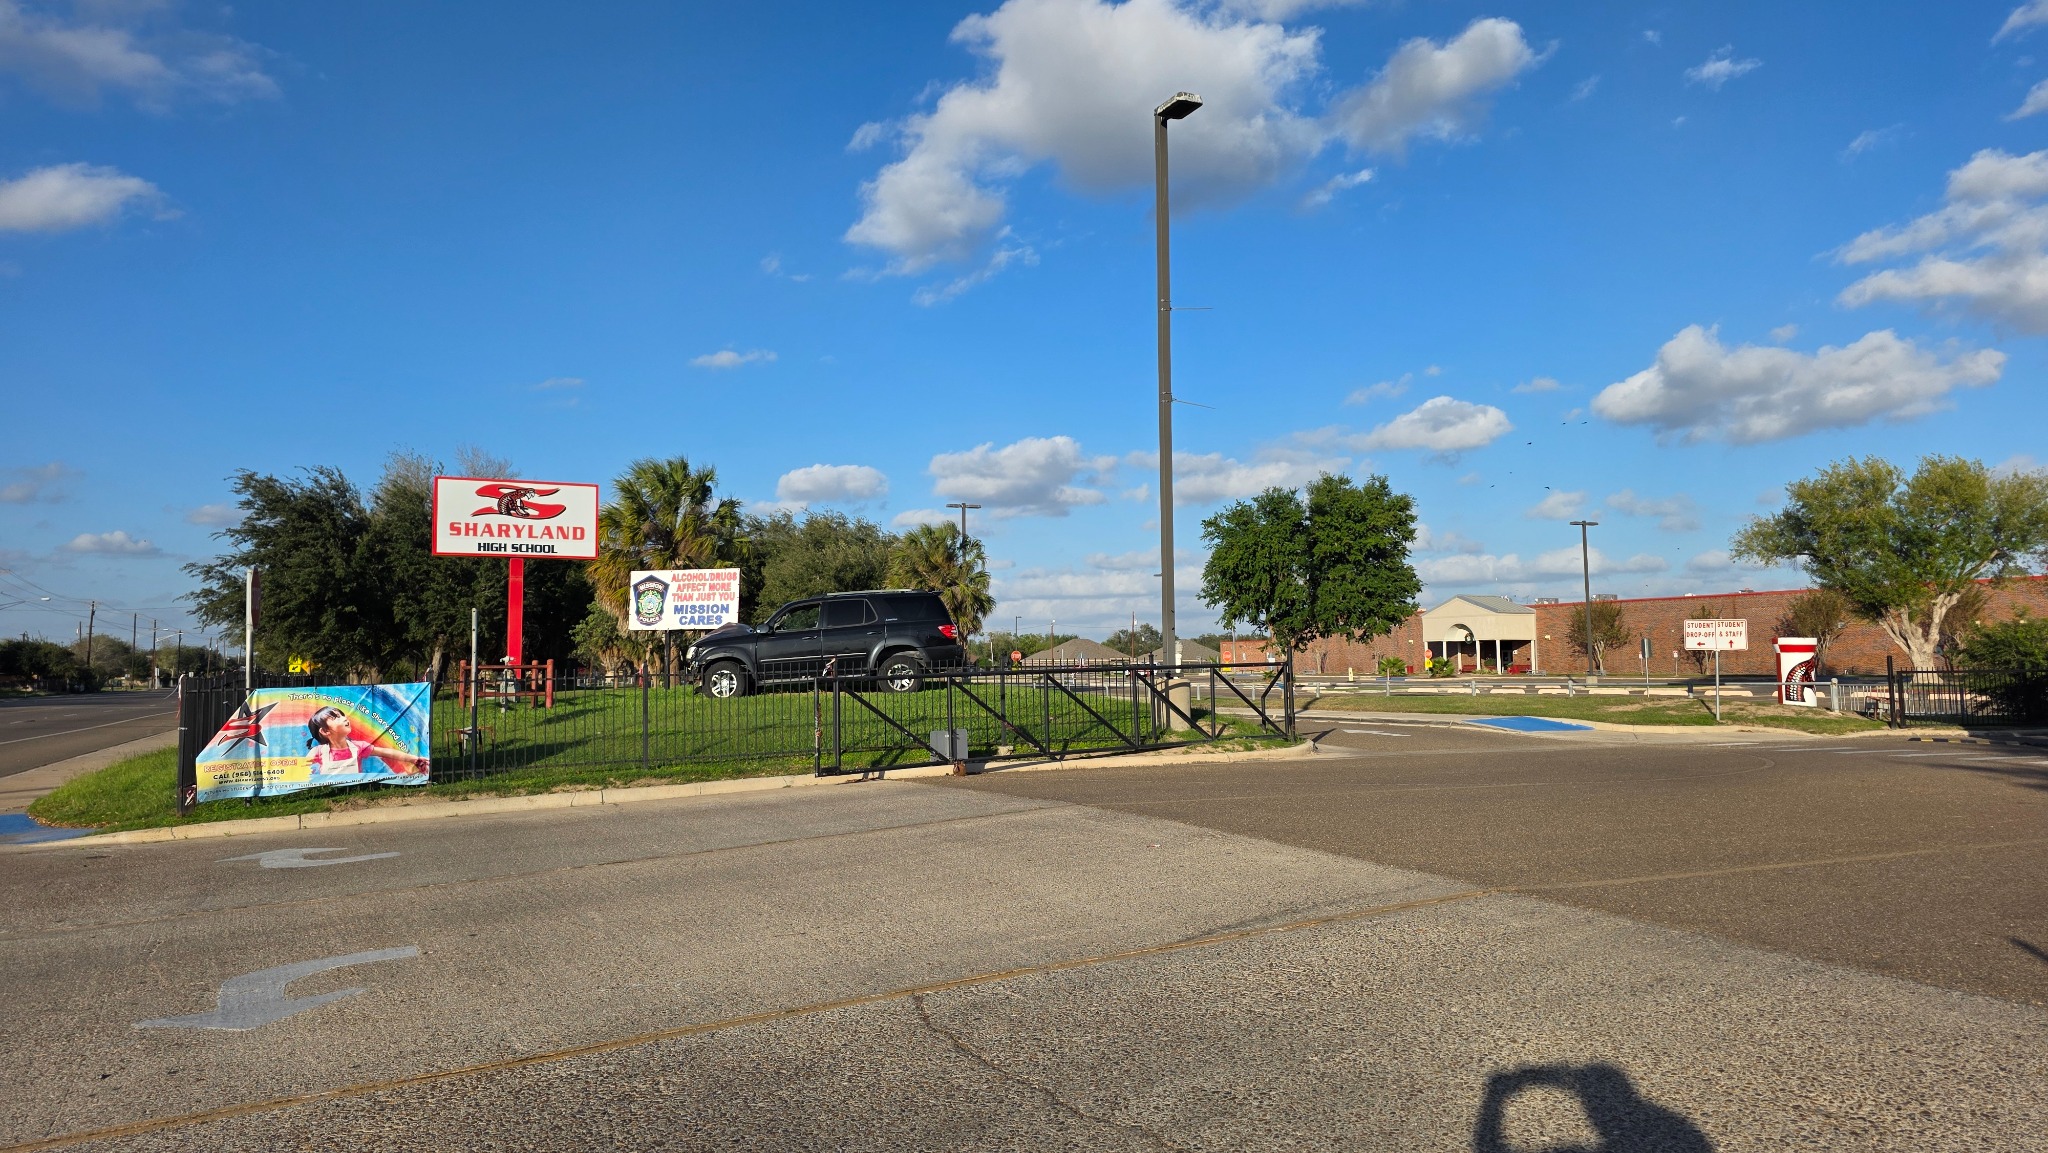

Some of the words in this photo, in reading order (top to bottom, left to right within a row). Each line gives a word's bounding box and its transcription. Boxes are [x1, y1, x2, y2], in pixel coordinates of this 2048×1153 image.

[449, 521, 585, 540] SHARYLAND
[477, 542, 507, 552] HIGH
[511, 543, 558, 554] SCHOOL
[671, 572, 737, 582] ALCOHOL/DRUGS
[639, 582, 664, 590] MISSION
[676, 583, 707, 592] AFFECT
[708, 582, 731, 591] MORE
[672, 593, 694, 602] THAN
[695, 592, 716, 601] JUST
[718, 592, 735, 601] YOU
[673, 604, 730, 615] MISSION
[679, 615, 723, 625] CARES
[288, 693, 320, 702] There's
[333, 696, 356, 707] place
[371, 711, 400, 741] sharyand
